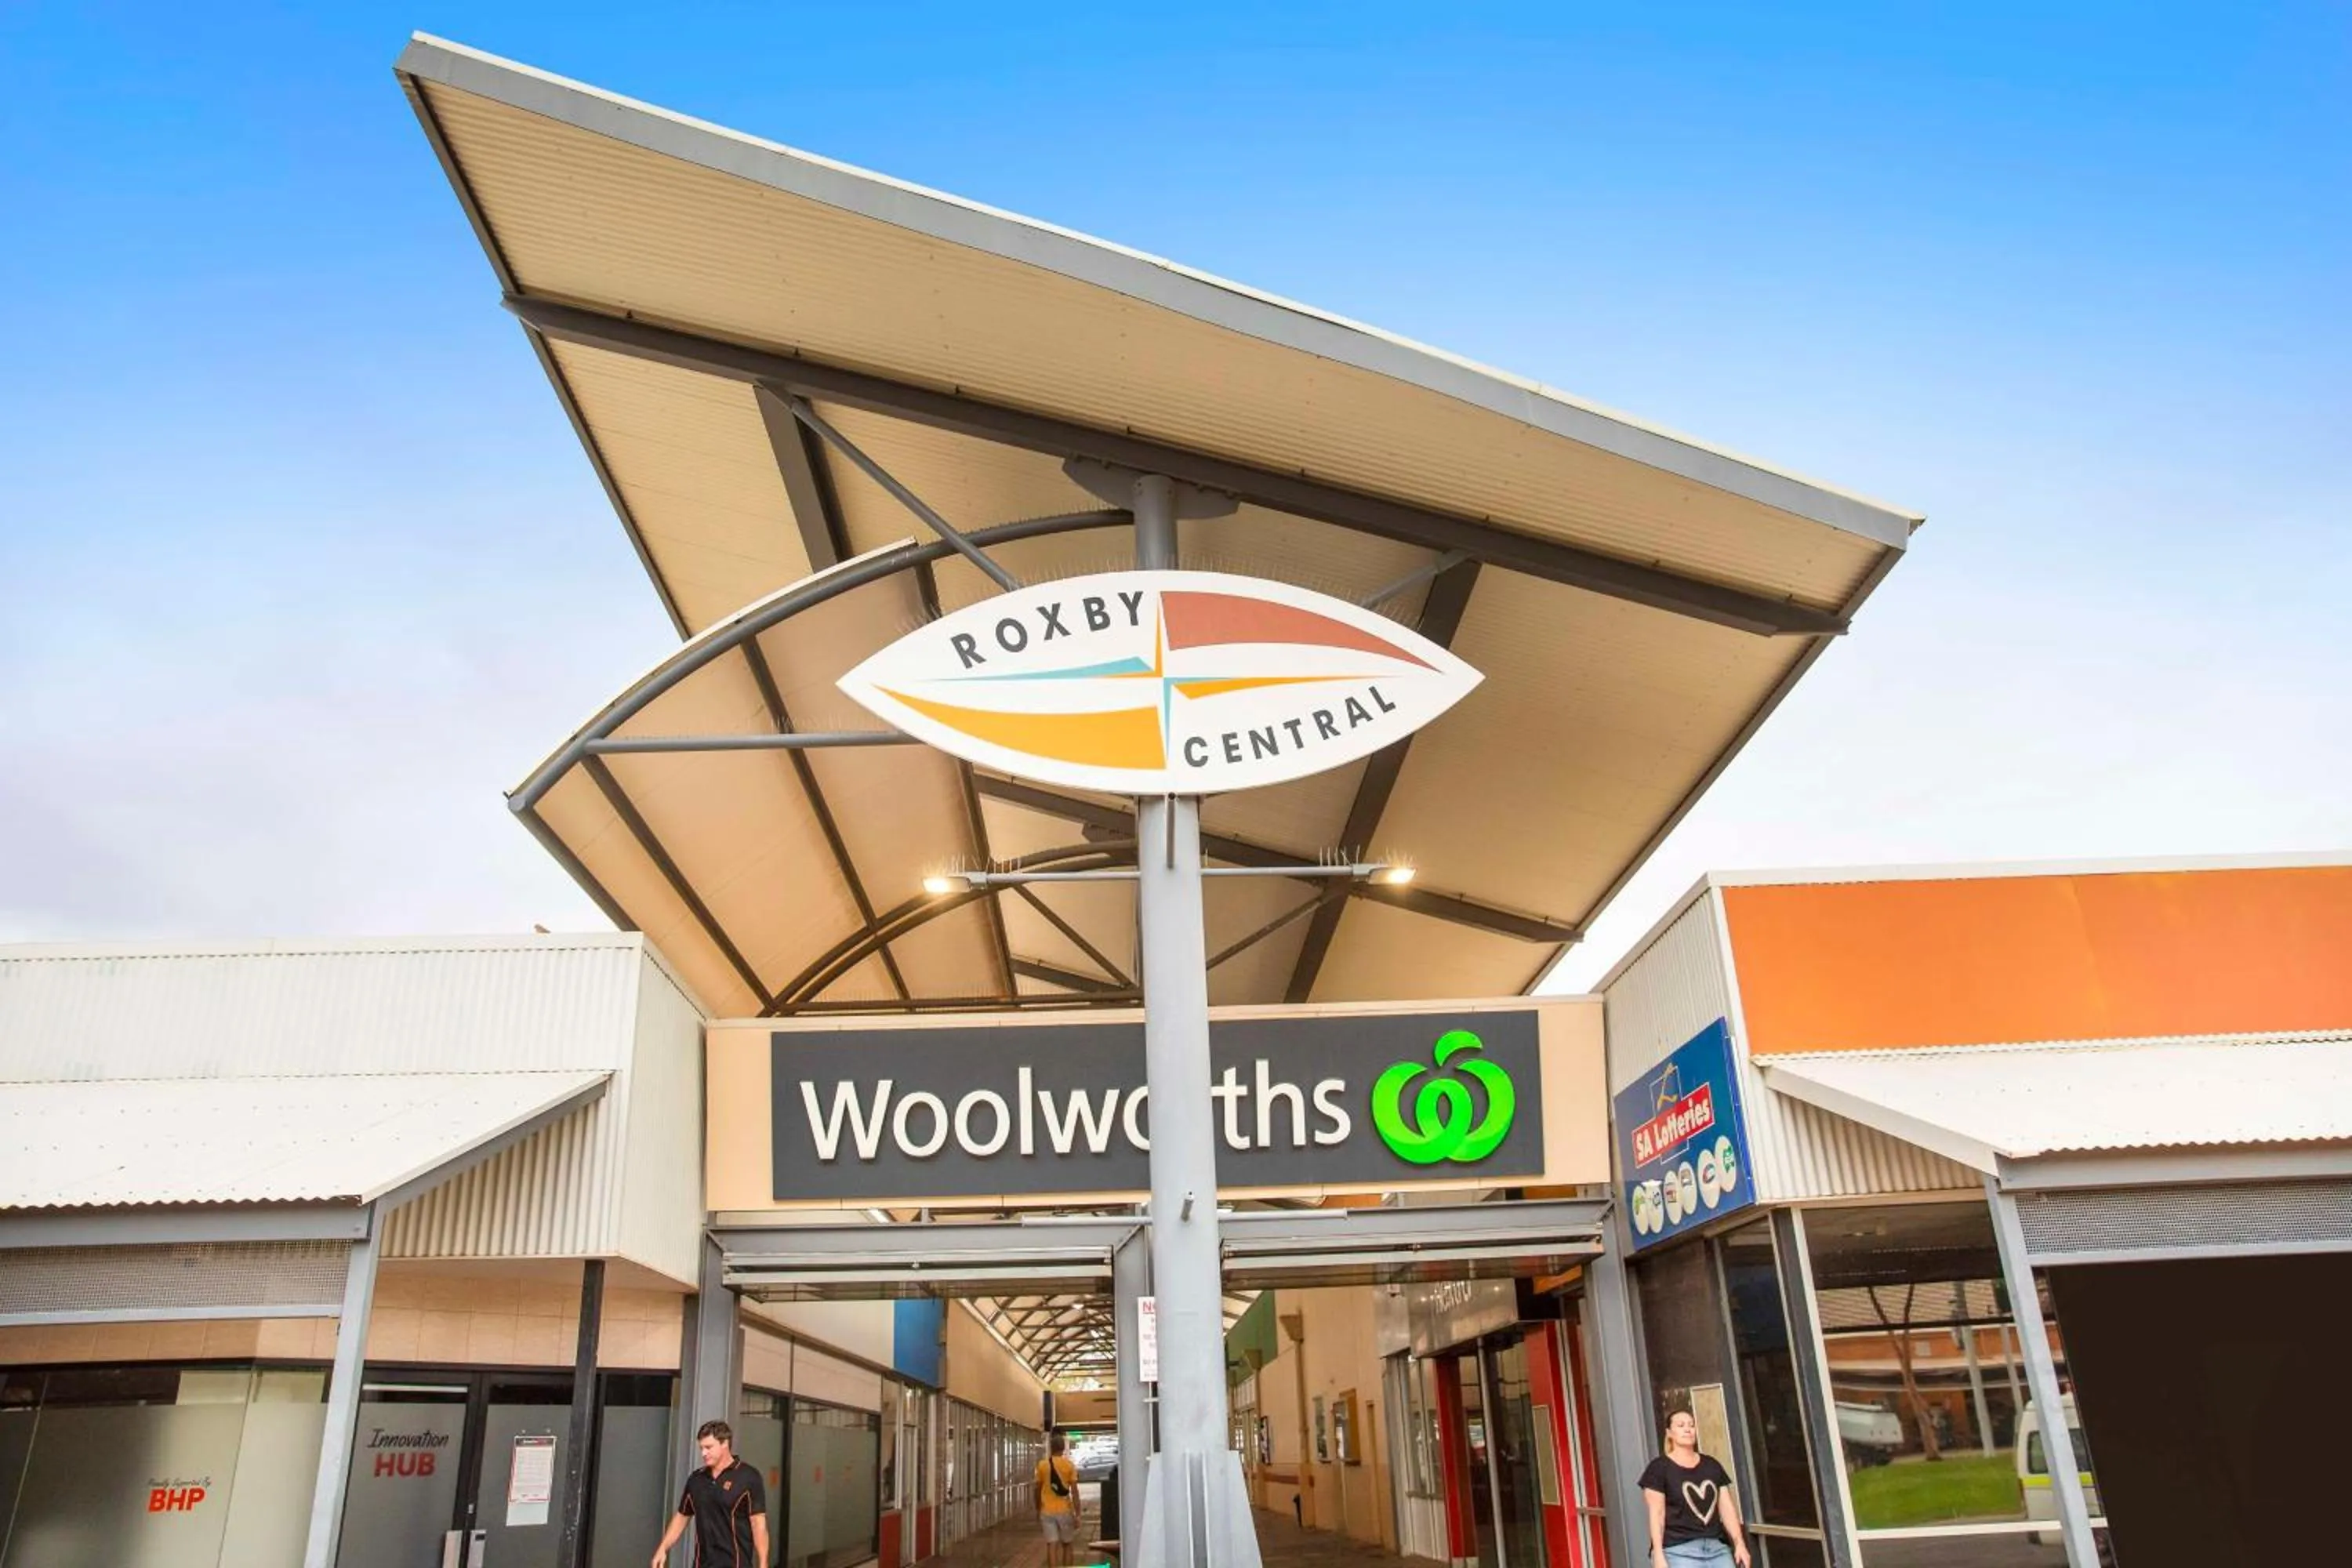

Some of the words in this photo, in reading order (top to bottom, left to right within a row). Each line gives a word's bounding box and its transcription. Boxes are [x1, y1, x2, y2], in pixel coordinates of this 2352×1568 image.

[950, 590, 1145, 669] ROXBY
[1183, 686, 1396, 768] CENTRAL
[800, 1060, 1351, 1160] Woolwths
[1635, 1128, 1653, 1160] SA
[1653, 1097, 1710, 1151] Lotteries
[366, 1428, 449, 1449] Innovation
[373, 1452, 435, 1478] HUB
[148, 1488, 205, 1512] BHP
